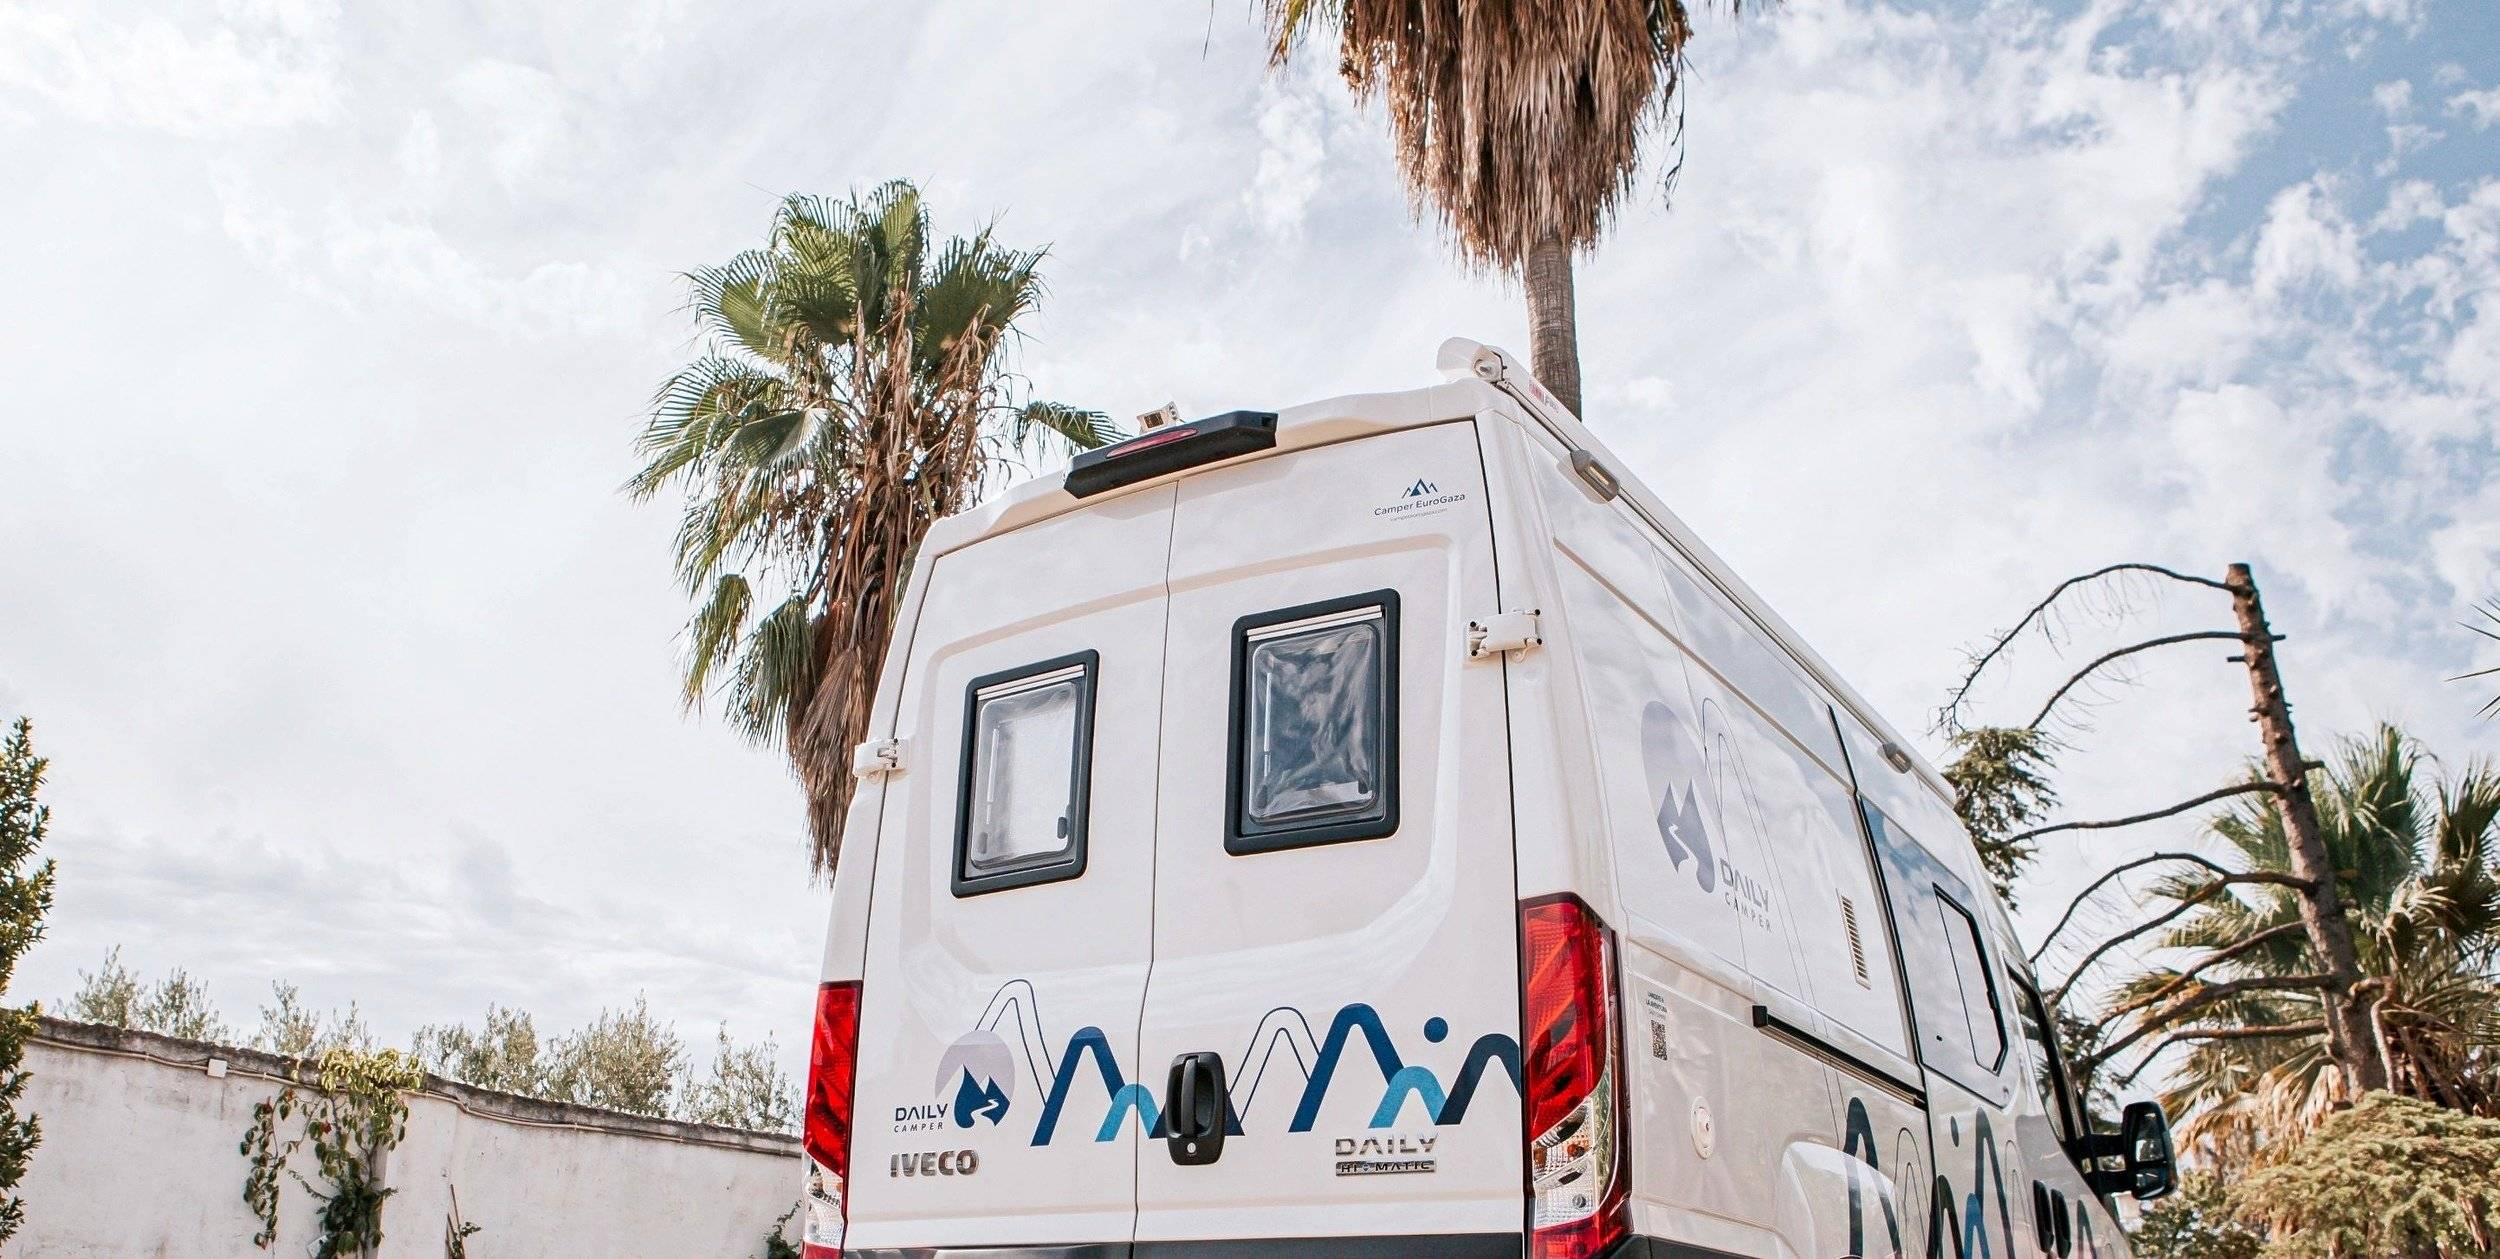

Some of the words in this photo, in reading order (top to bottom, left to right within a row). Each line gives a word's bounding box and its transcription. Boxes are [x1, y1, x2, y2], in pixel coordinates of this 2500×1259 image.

[1374, 503, 1413, 516] Camper
[1416, 493, 1466, 508] EuroGaza
[1720, 858, 1768, 912] DAILY
[1725, 892, 1772, 932] CAMPER
[895, 1103, 948, 1121] DAILY
[894, 1121, 943, 1133] CAMPER
[1336, 1134, 1438, 1156] DAILY
[890, 1149, 979, 1178] IVECO
